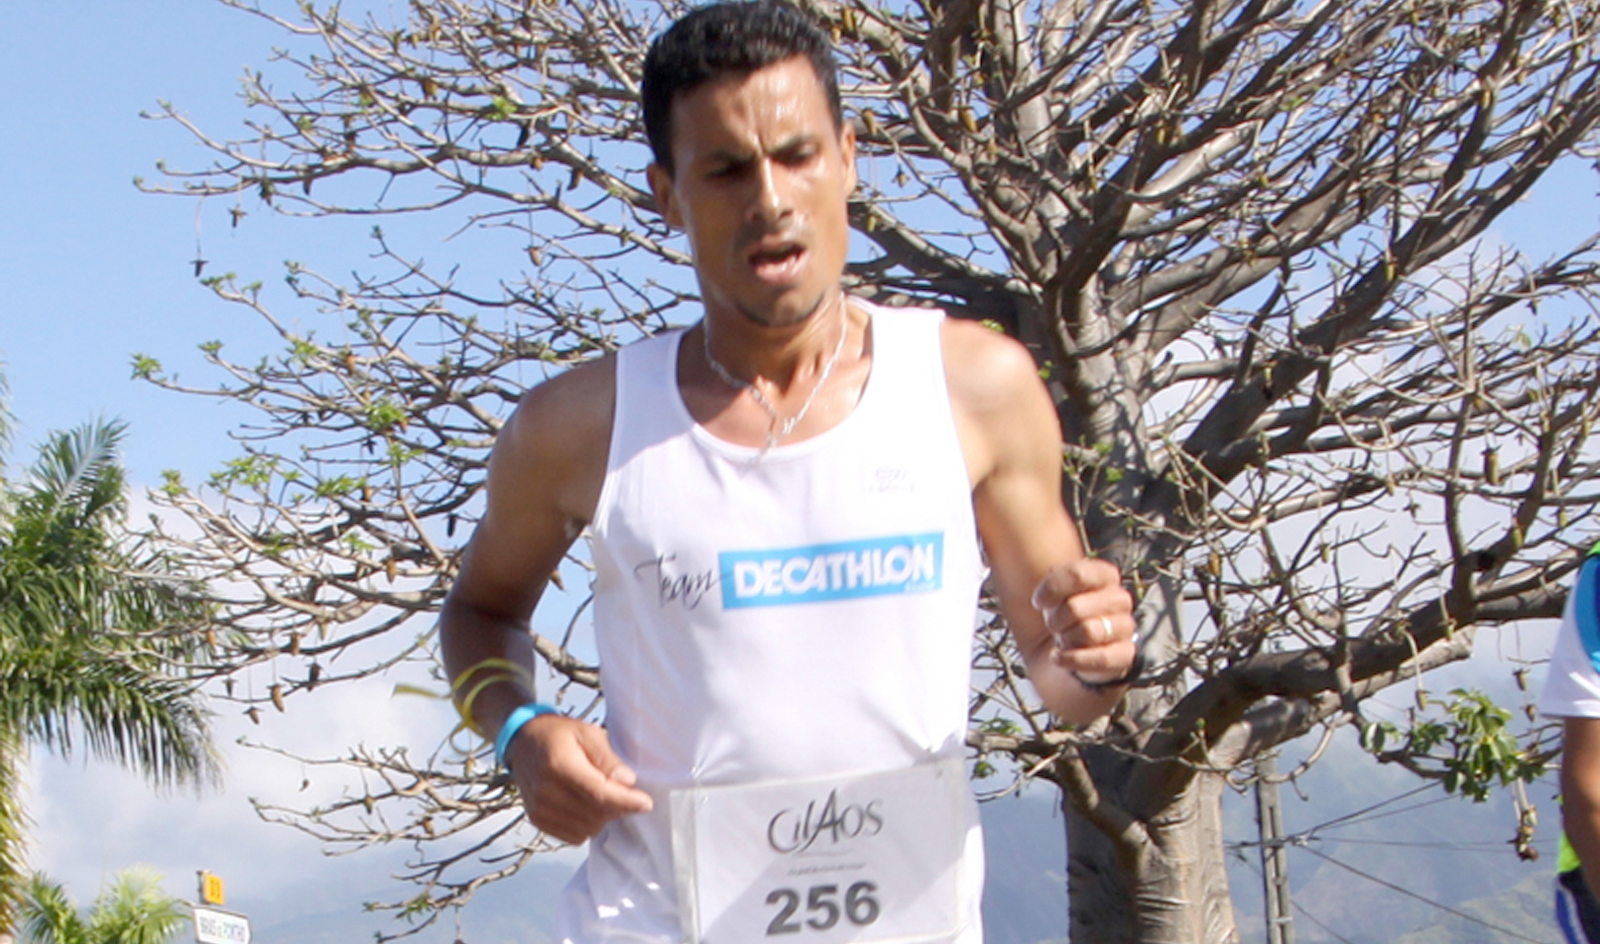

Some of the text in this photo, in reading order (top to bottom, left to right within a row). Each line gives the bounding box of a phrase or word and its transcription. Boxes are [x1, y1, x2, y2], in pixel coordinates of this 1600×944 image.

[634, 542, 935, 611] Team DECATHLON
[764, 881, 881, 937] 256
